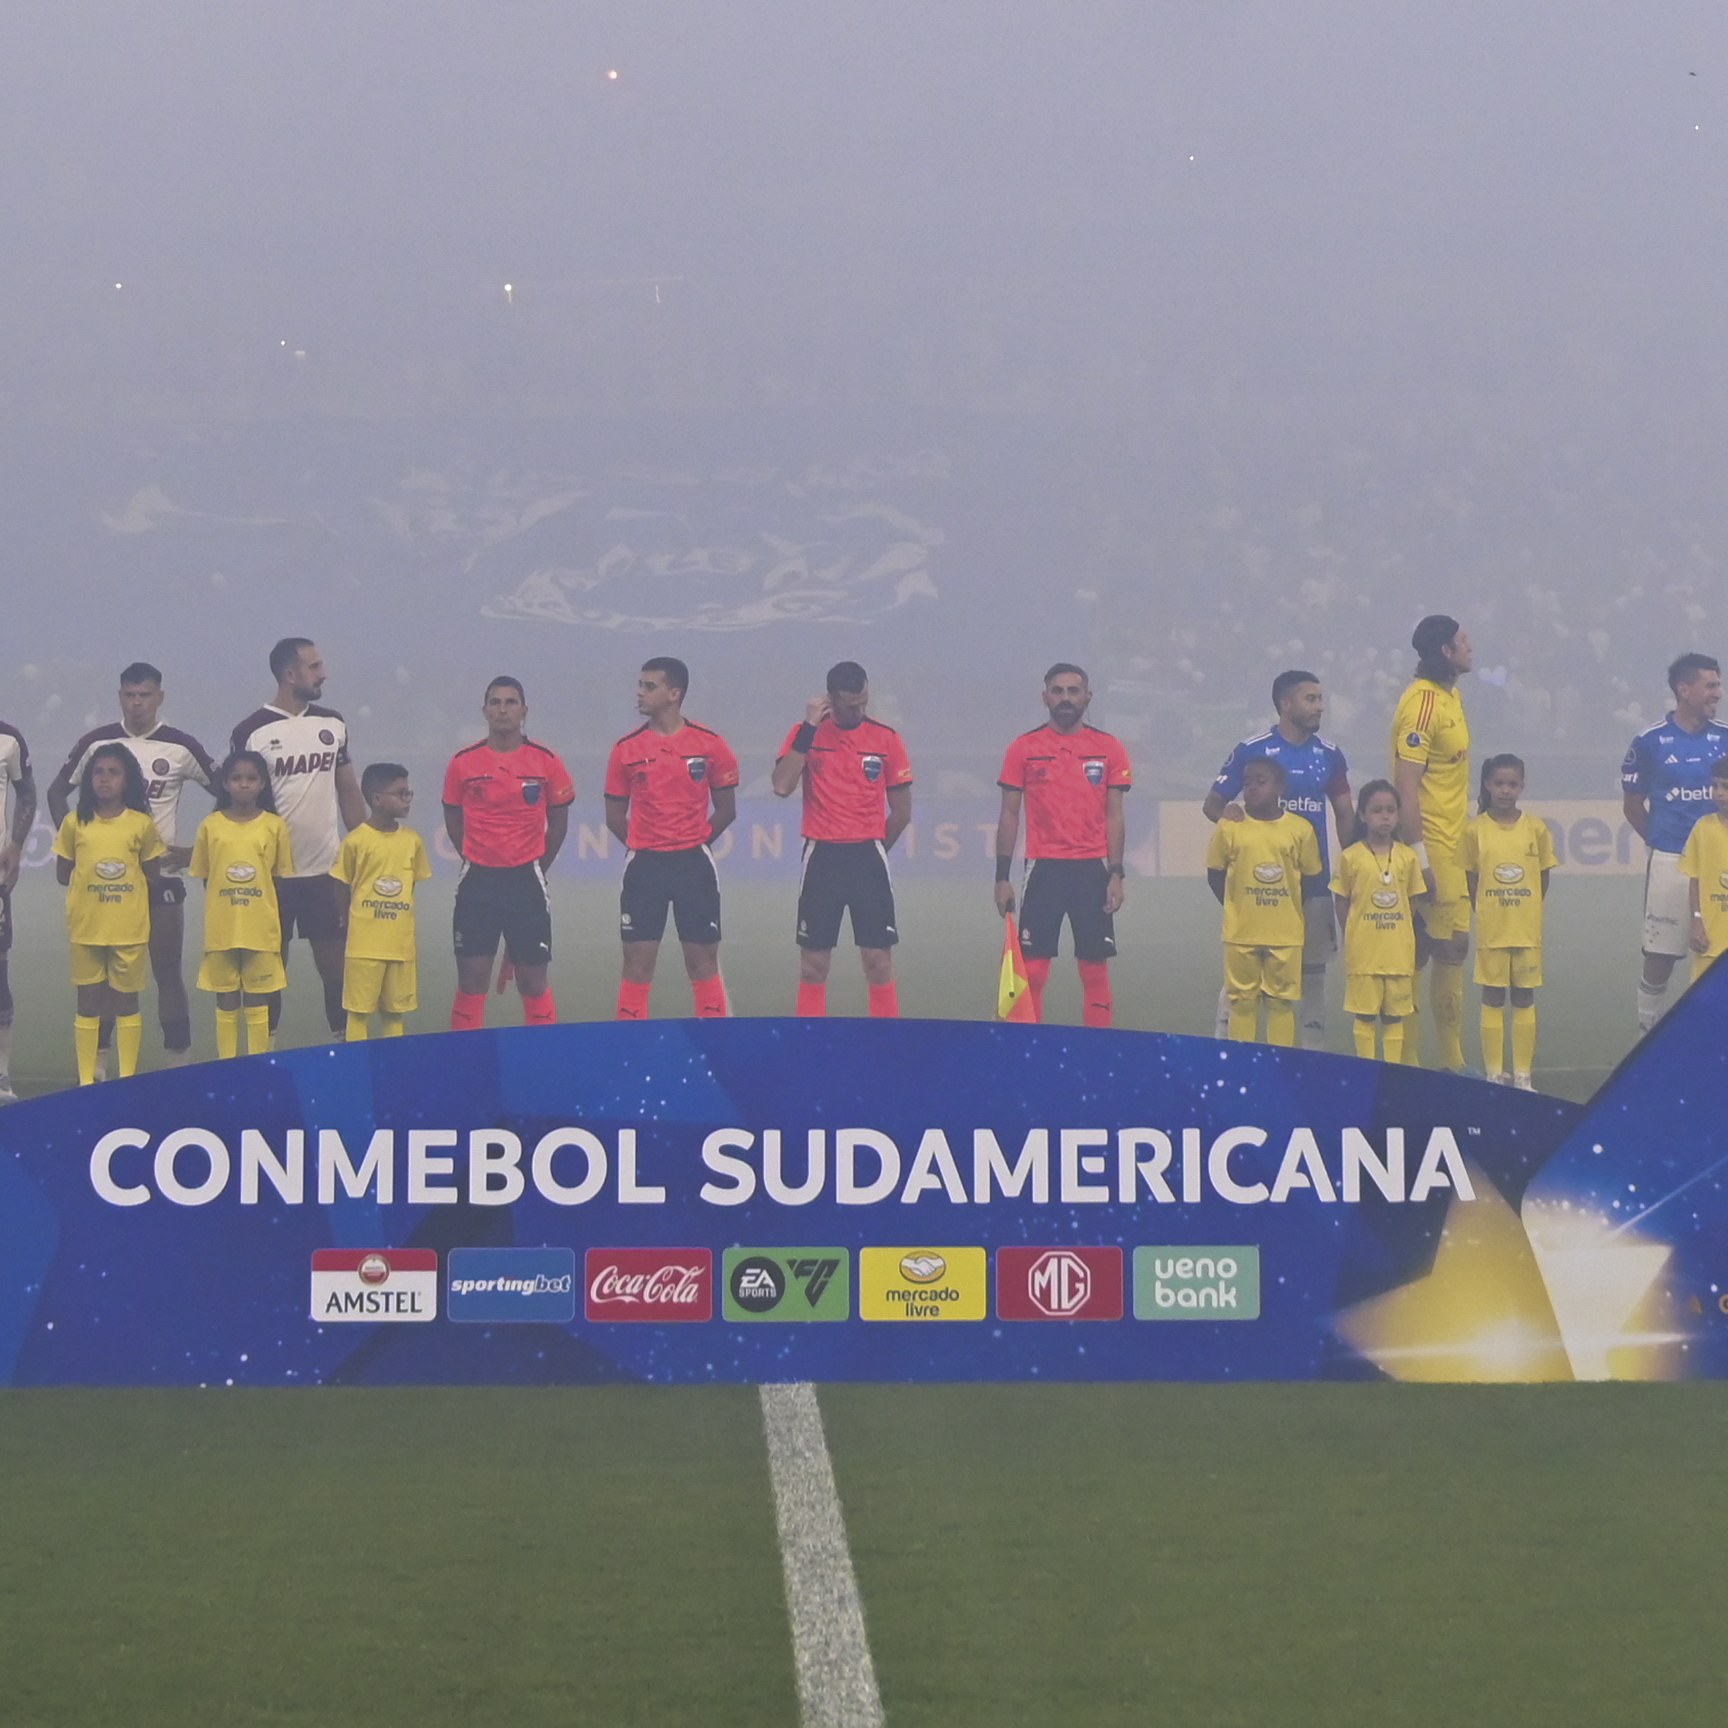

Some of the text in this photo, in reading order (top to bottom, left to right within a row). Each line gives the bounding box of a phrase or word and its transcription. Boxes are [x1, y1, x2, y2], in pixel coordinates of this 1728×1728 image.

[275, 752, 334, 776] MAPEI
[87, 882, 134, 893] mercado
[220, 888, 264, 898] mercado
[1486, 888, 1532, 898] mercado
[99, 893, 122, 903] livre
[362, 898, 410, 911] mercado
[1256, 896, 1279, 907] livre
[1499, 898, 1520, 908] livre
[374, 909, 398, 920] livre
[1376, 921, 1396, 931] livre
[89, 1125, 1476, 1207] CONMEBOL SUDAMERICANA
[1155, 1257, 1238, 1279] ueno
[451, 1274, 571, 1296] sportingbet
[590, 1265, 706, 1304] Coca-Cola
[740, 1268, 775, 1288] EA
[1034, 1257, 1085, 1310] MG
[738, 1288, 777, 1299] SPORTS
[886, 1287, 960, 1302] mercado
[1155, 1280, 1237, 1308] bank
[325, 1291, 423, 1314] AMSTEL
[905, 1302, 940, 1317] livre
[1689, 1295, 1703, 1314] A
